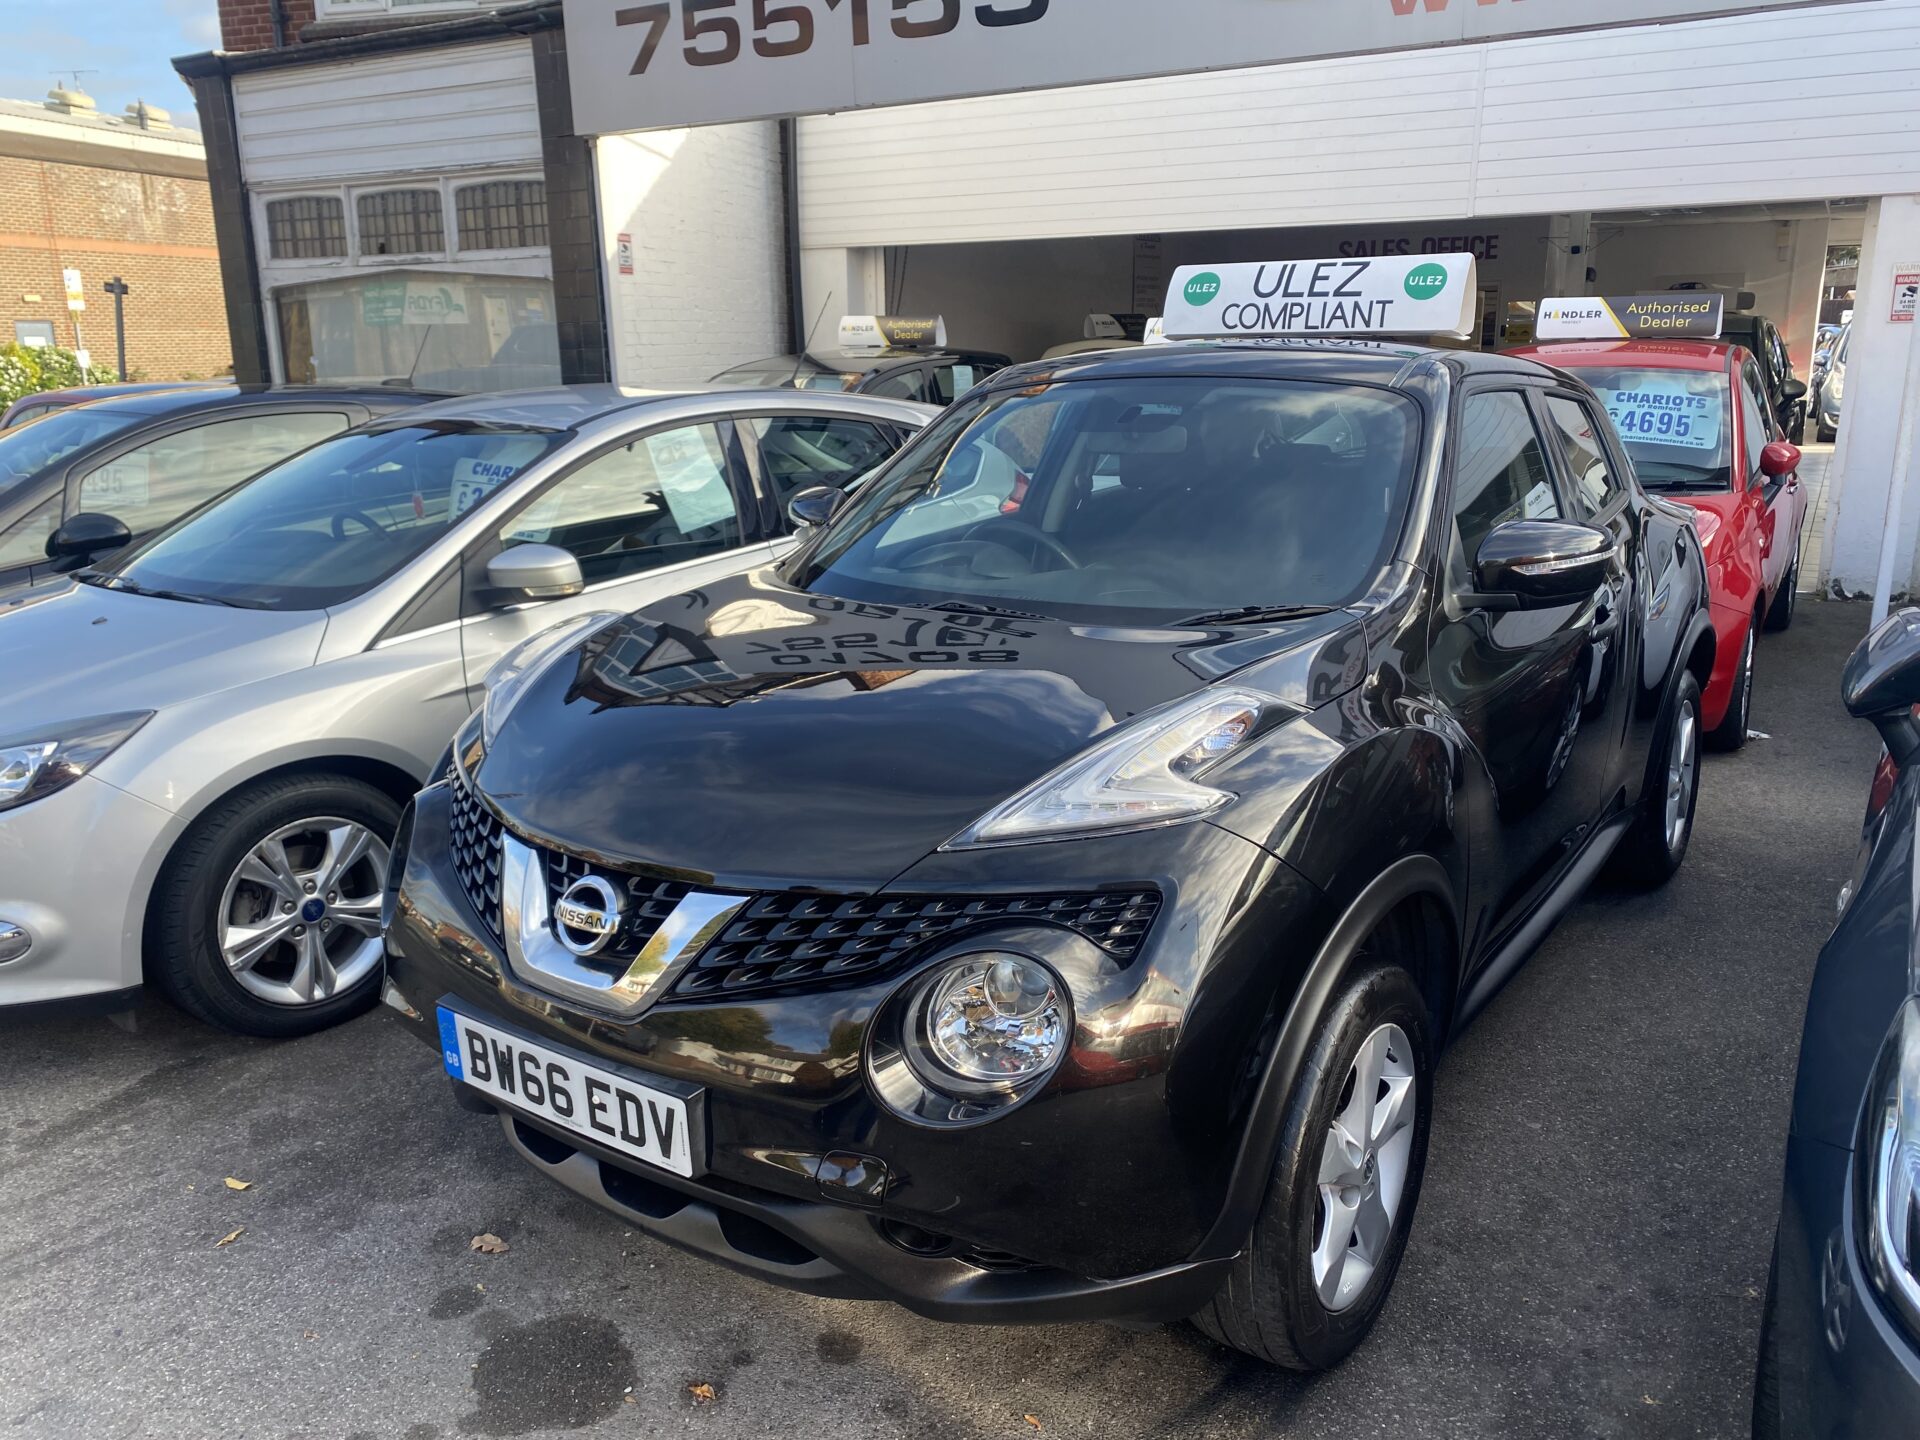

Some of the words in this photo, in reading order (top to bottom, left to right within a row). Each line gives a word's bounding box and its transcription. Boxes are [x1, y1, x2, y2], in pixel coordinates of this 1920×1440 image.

[1338, 238, 1410, 257] SALES
[1421, 235, 1499, 260] OFFICE
[1253, 261, 1371, 298] ULEZ
[1409, 275, 1443, 286] ULEZ
[1187, 283, 1218, 293] ULEZ
[1221, 300, 1393, 330] COMPLIANT
[1544, 309, 1602, 320] HANDLER
[1626, 300, 1711, 315] Authorised
[887, 320, 933, 329] Authorised
[1640, 316, 1692, 328] Dealer
[894, 330, 923, 339] Dealer
[1615, 391, 1706, 409] CHARIOTS
[472, 462, 519, 478] CHAR
[557, 904, 608, 929] NISSAN
[446, 1050, 460, 1068] GB
[464, 1027, 575, 1119] BW66
[584, 1076, 675, 1160] EDV
